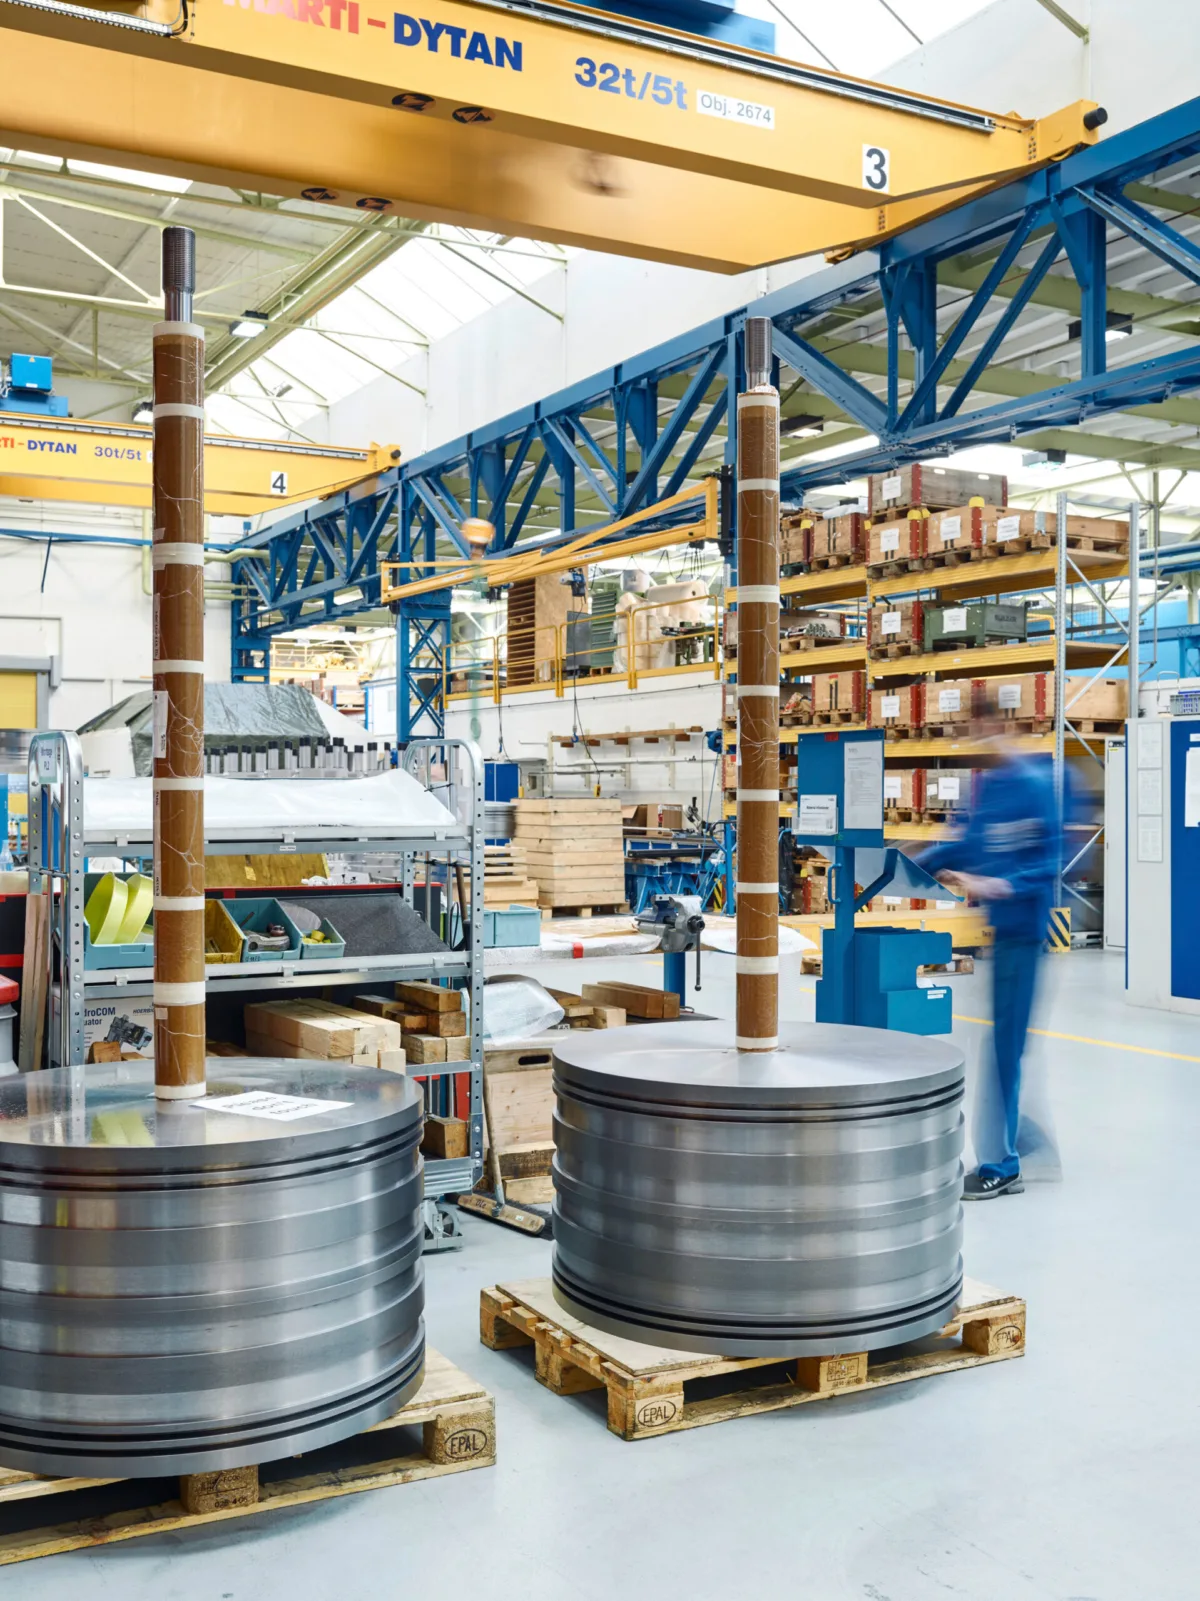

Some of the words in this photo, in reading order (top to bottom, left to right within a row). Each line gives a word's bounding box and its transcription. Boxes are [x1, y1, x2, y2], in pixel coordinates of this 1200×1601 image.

[574, 57, 688, 110] 32t/5t
[701, 94, 732, 116] Obj.
[736, 102, 772, 123] 2674
[865, 147, 888, 190] 3
[94, 446, 142, 461] 30t/5t
[271, 473, 287, 494] 4
[643, 1405, 670, 1424] EPAL
[450, 1433, 480, 1455] EPAL
